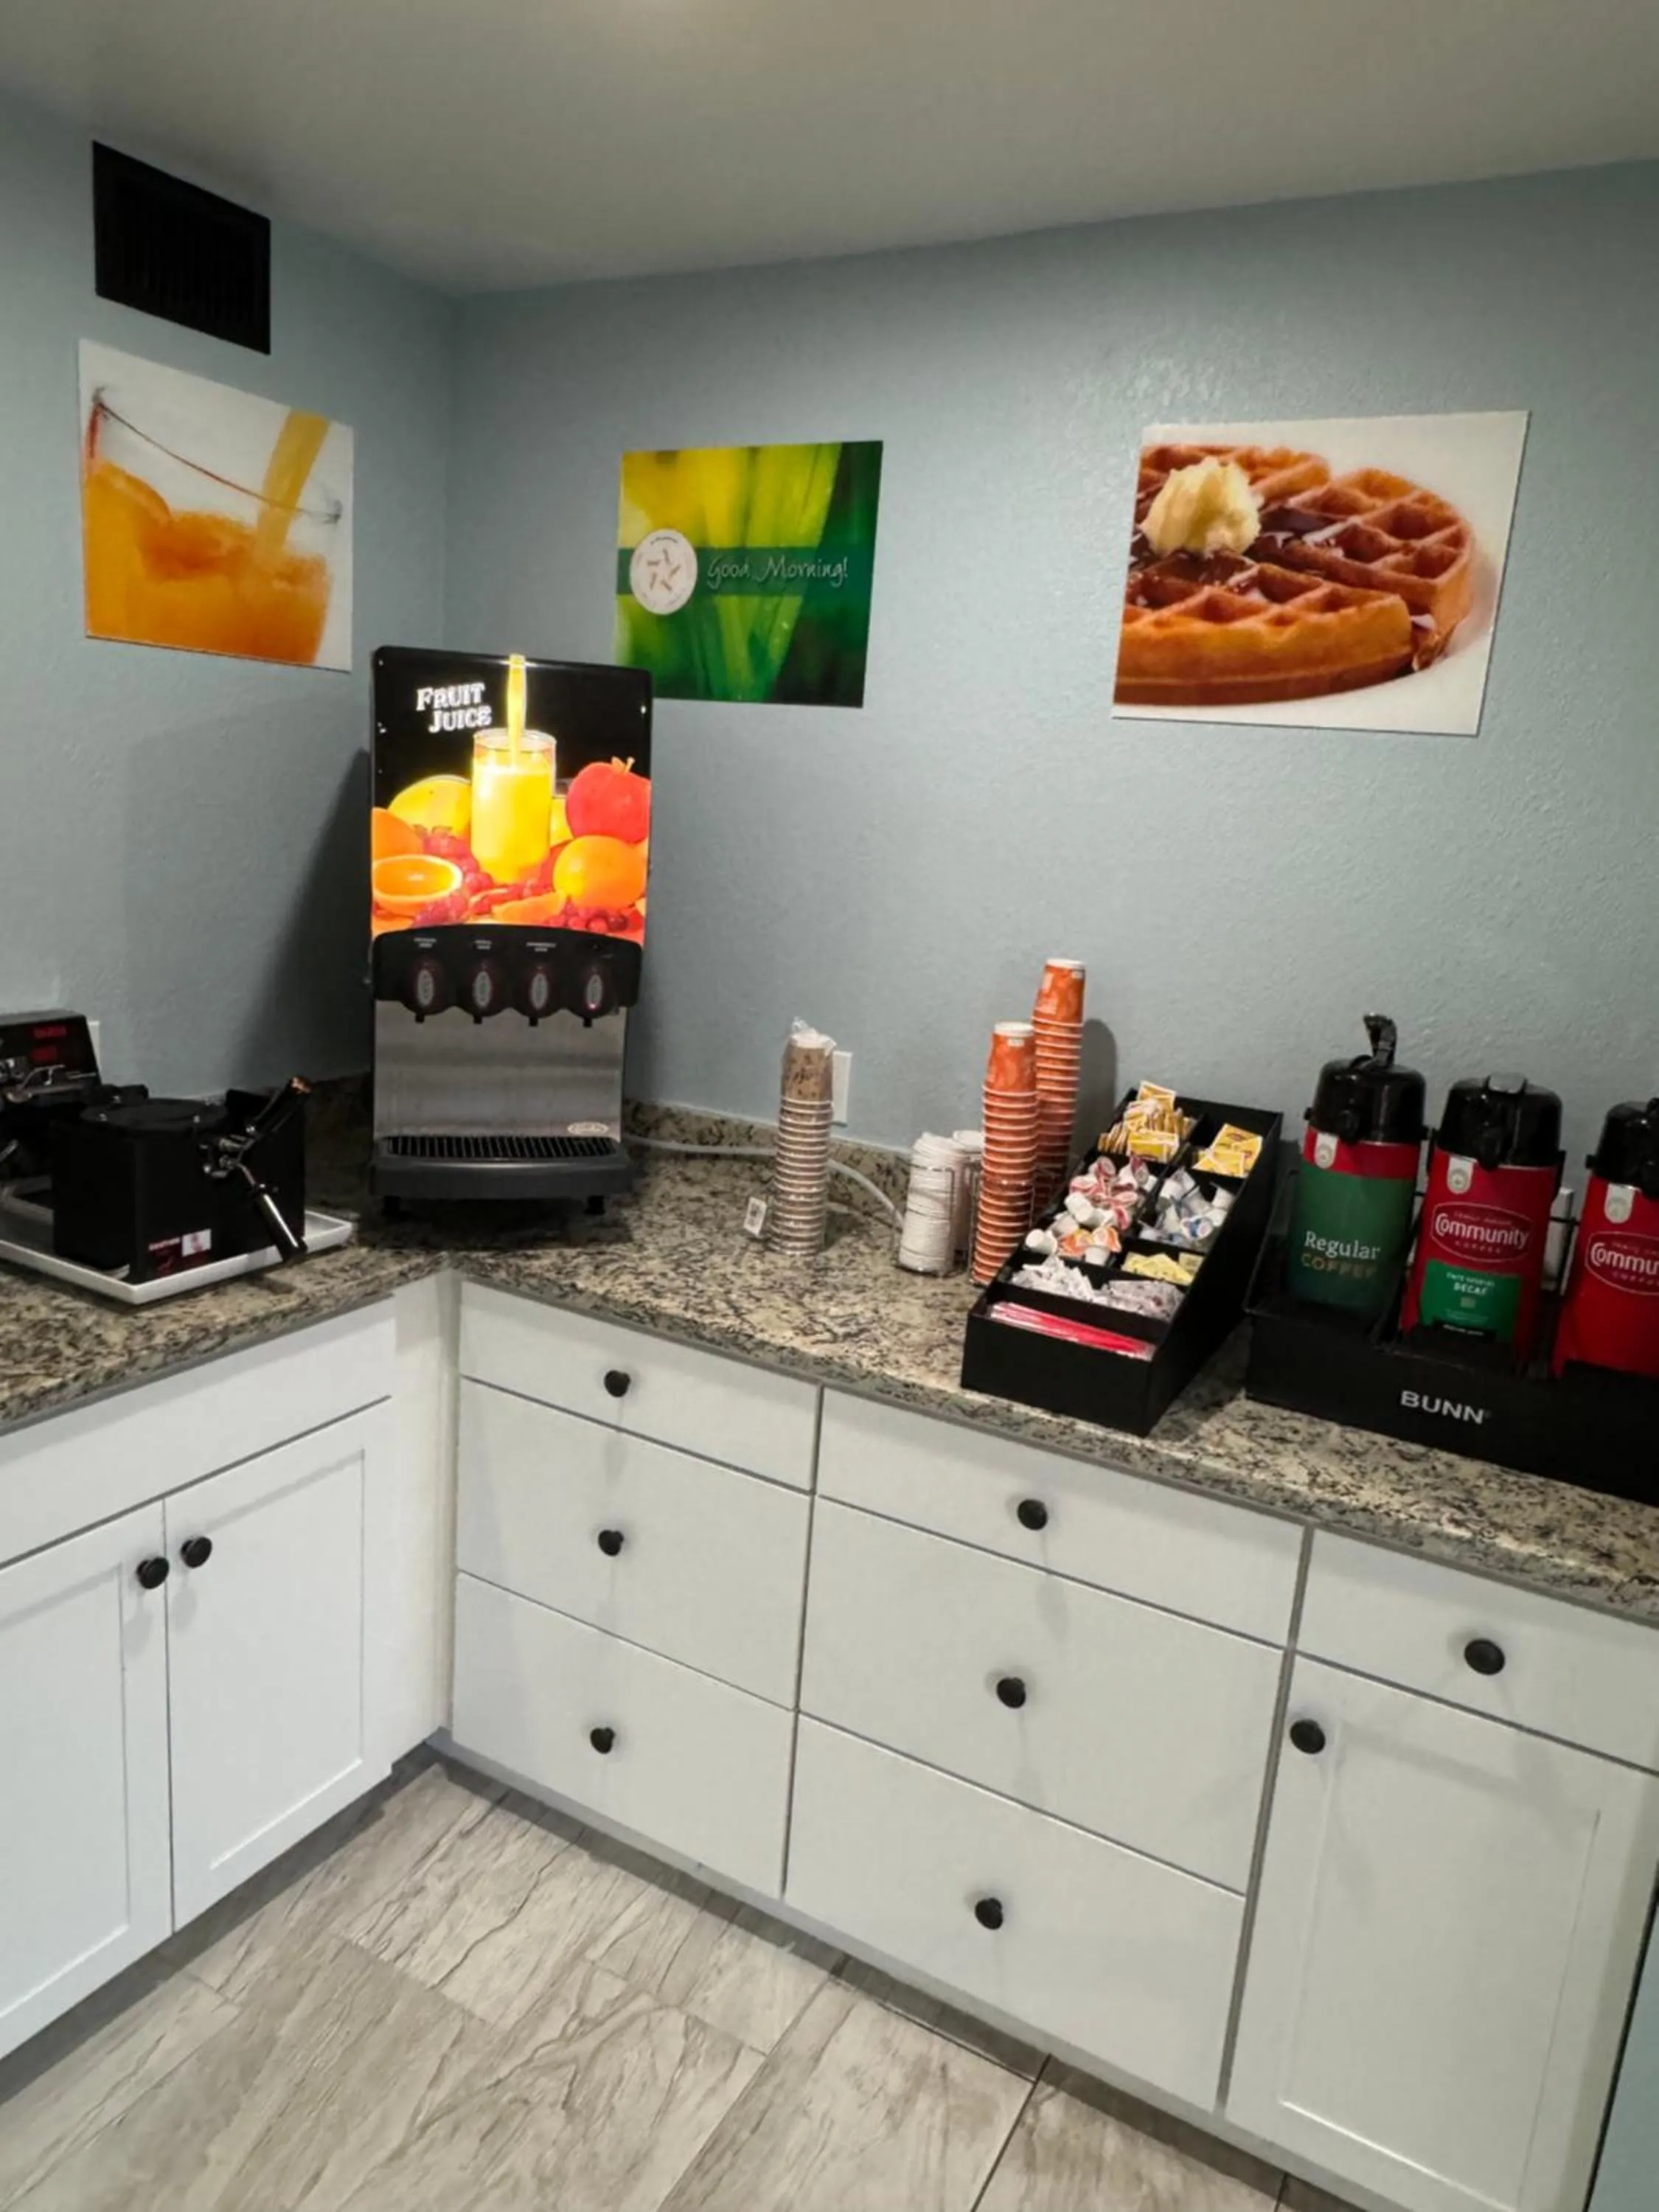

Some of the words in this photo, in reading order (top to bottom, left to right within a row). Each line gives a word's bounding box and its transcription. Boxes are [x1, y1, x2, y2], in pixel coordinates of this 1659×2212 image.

[707, 555, 751, 589] Good
[754, 554, 848, 588] Morning!
[416, 682, 485, 711] FRUIT
[428, 705, 493, 734] JUICE
[1304, 1230, 1381, 1260] Regular
[1434, 1212, 1529, 1251] Community
[1402, 1390, 1484, 1425] BUNN
